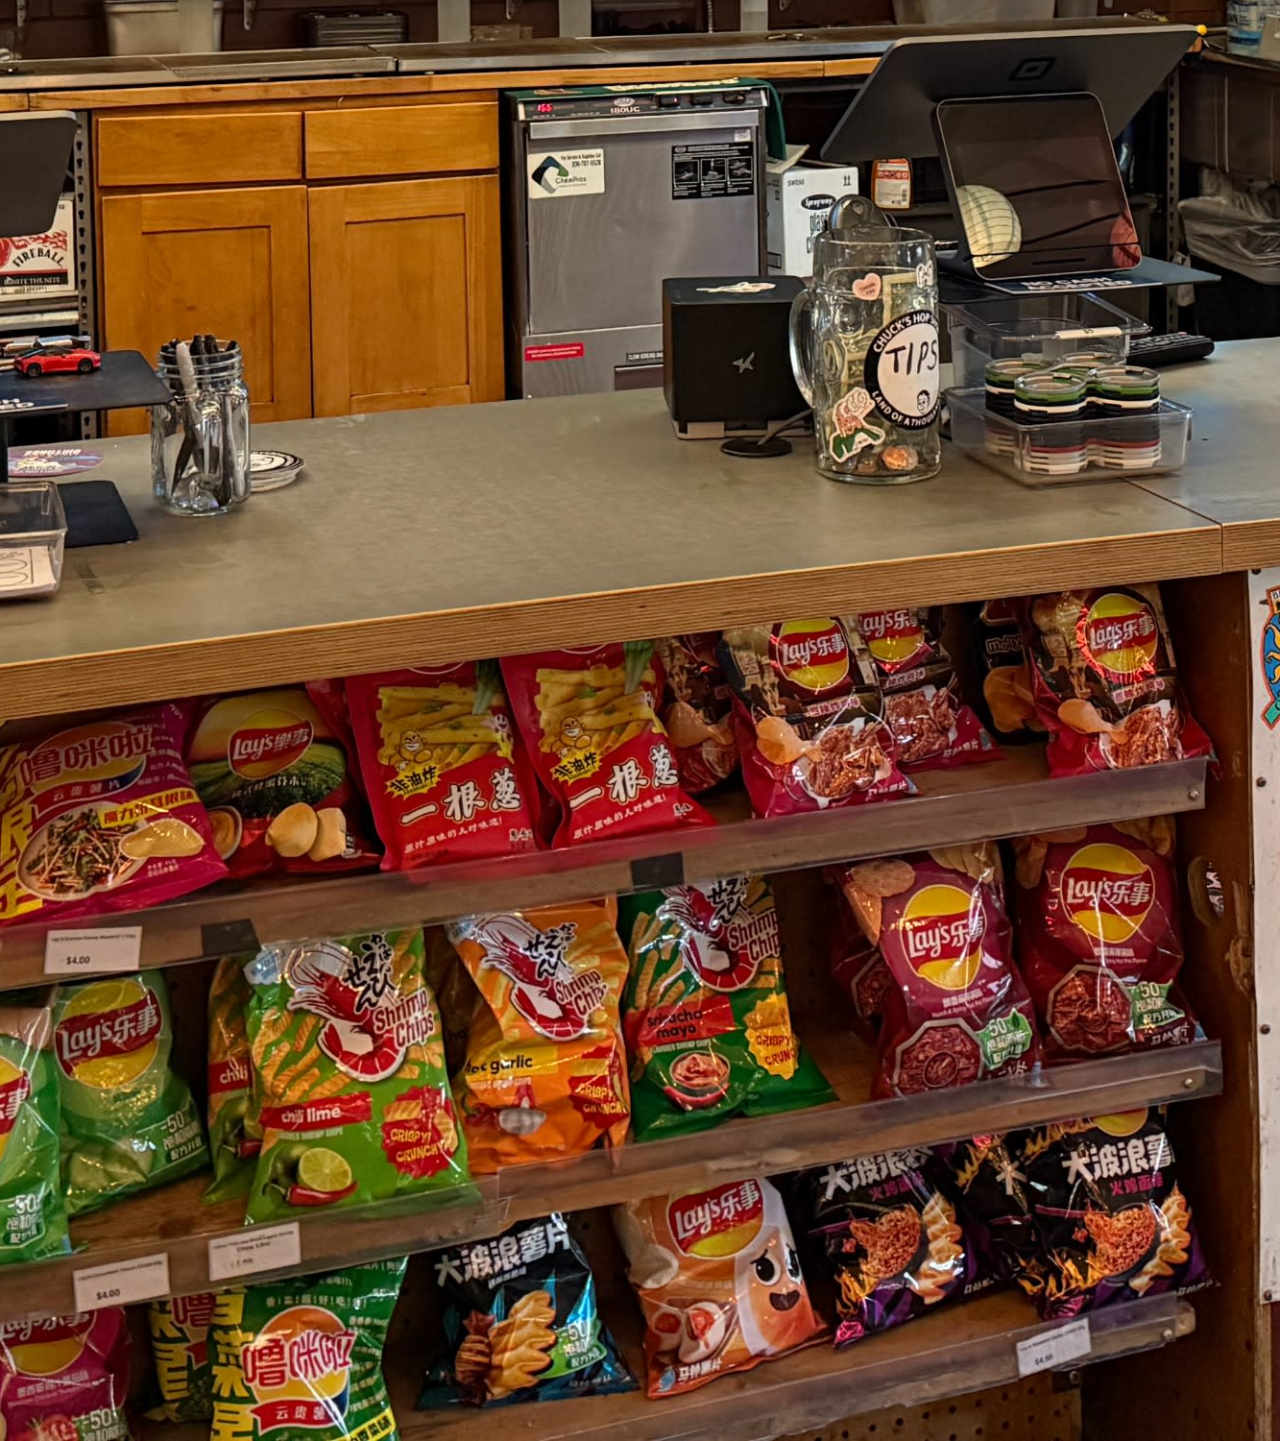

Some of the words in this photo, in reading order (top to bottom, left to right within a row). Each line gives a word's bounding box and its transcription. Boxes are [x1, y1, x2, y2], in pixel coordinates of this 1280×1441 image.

[12, 247, 66, 268] FIREBALL
[873, 315, 912, 352] CHUCK'S
[885, 340, 937, 376] TIPS
[871, 390, 892, 419] LAND
[65, 955, 91, 967] $4.00
[373, 990, 429, 1033] Shrimp
[395, 1014, 435, 1050] Chips
[281, 1107, 304, 1125] chili
[307, 1106, 342, 1122] lime
[434, 1223, 571, 1286] 大波浪薯片
